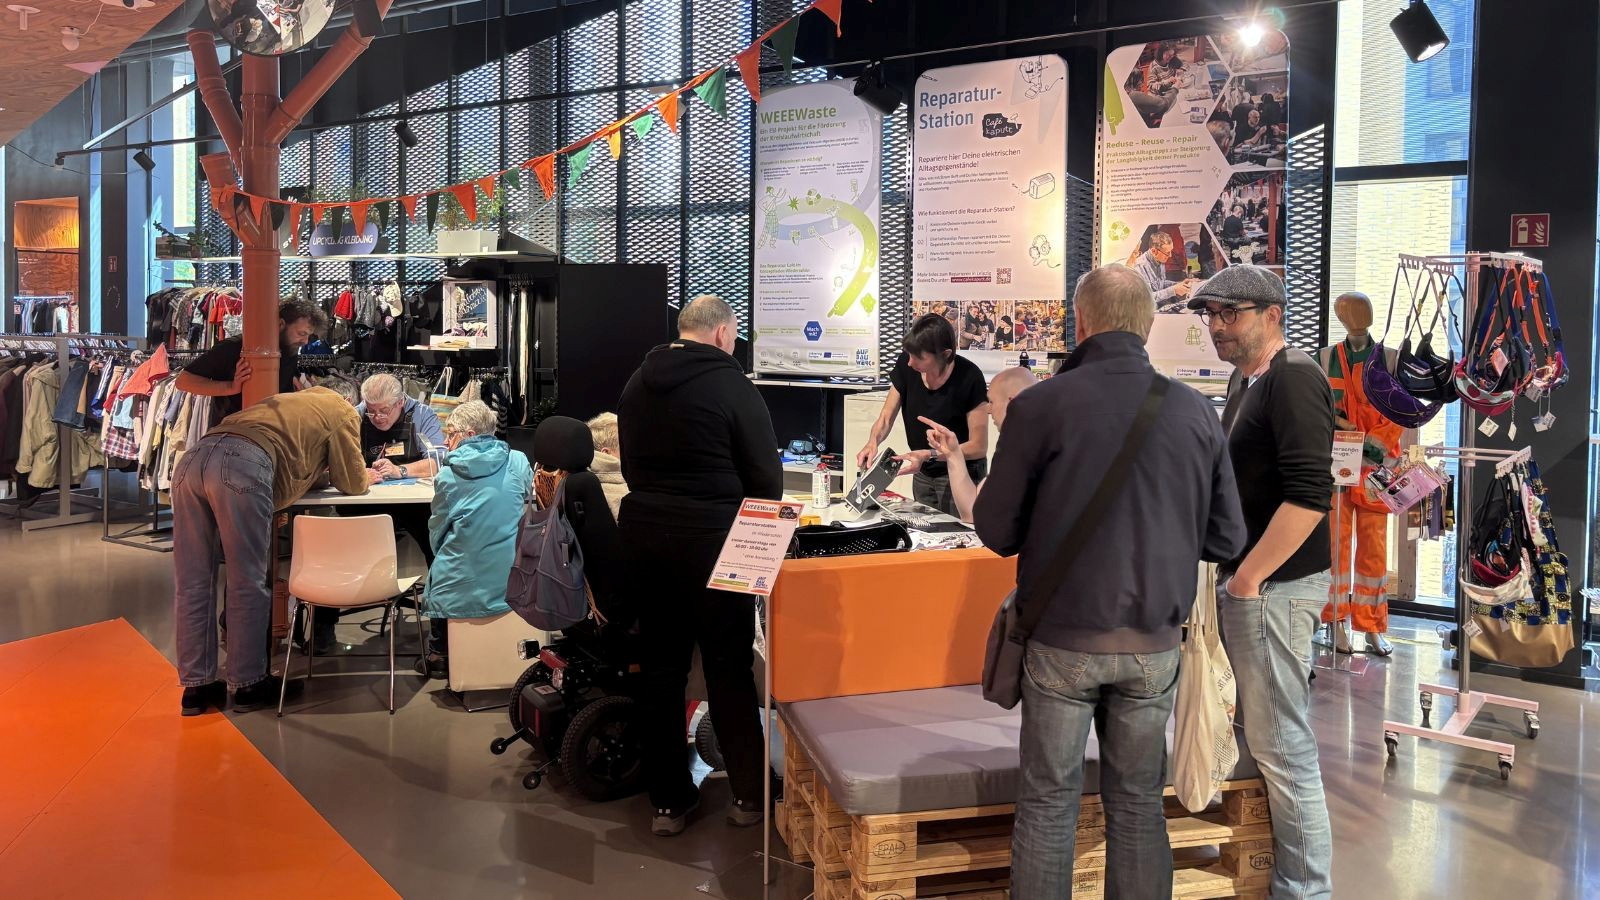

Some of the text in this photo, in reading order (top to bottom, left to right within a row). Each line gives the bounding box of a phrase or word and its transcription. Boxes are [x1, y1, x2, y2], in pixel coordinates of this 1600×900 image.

[920, 86, 1002, 109] Reparatur-
[760, 106, 836, 124] WEEEWaste
[919, 111, 974, 130] Station
[1172, 135, 1198, 144] Repair
[919, 155, 948, 164] Repariere
[982, 149, 1021, 158] elektrischen
[919, 160, 980, 172] Alltagsgegenstände!
[746, 504, 777, 512] WEEEWaste
[1254, 856, 1274, 867] EPAL
